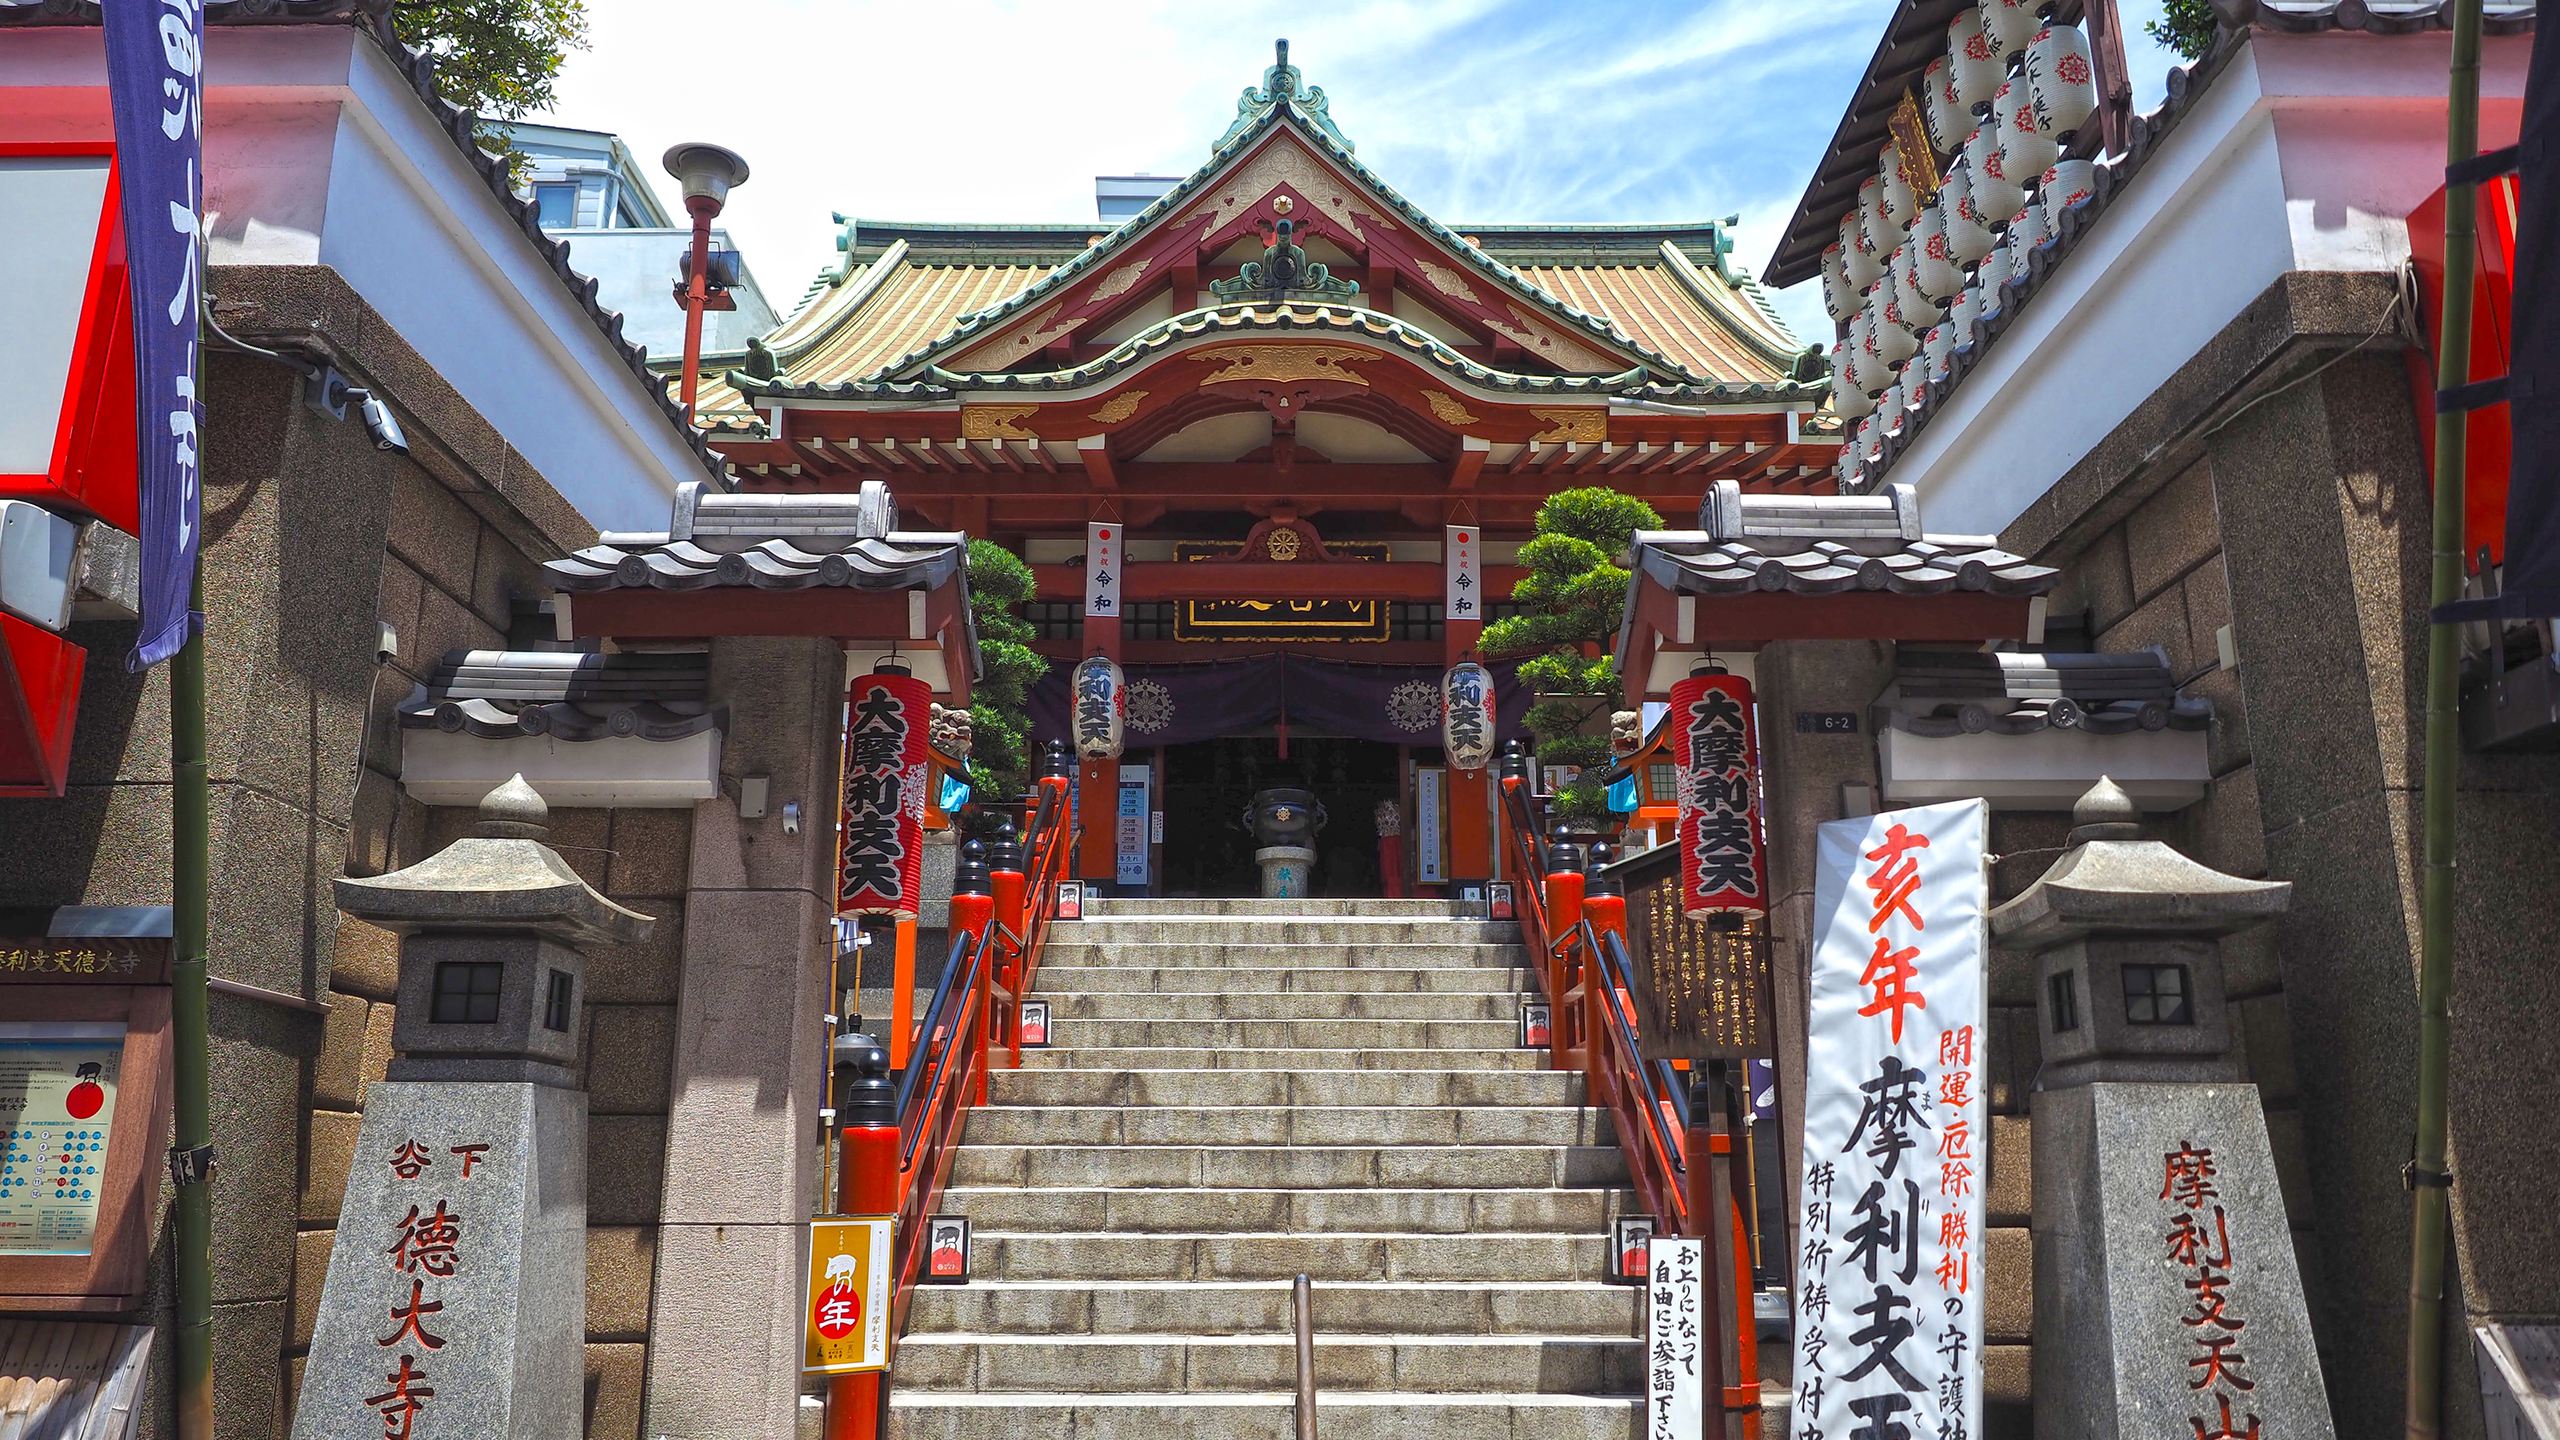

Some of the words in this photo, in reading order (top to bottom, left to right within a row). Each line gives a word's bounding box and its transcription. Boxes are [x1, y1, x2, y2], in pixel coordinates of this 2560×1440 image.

[1094, 570, 1113, 612] 令和
[1455, 573, 1473, 615] 令和
[842, 687, 906, 899] 大摩利支天
[1690, 689, 1758, 897] 大摩利支天
[1825, 717, 1849, 728] 6-2
[1857, 823, 1931, 1047] 亥年
[1674, 1246, 1699, 1376] お上りになって
[2159, 1140, 2262, 1440] 摩利支天山
